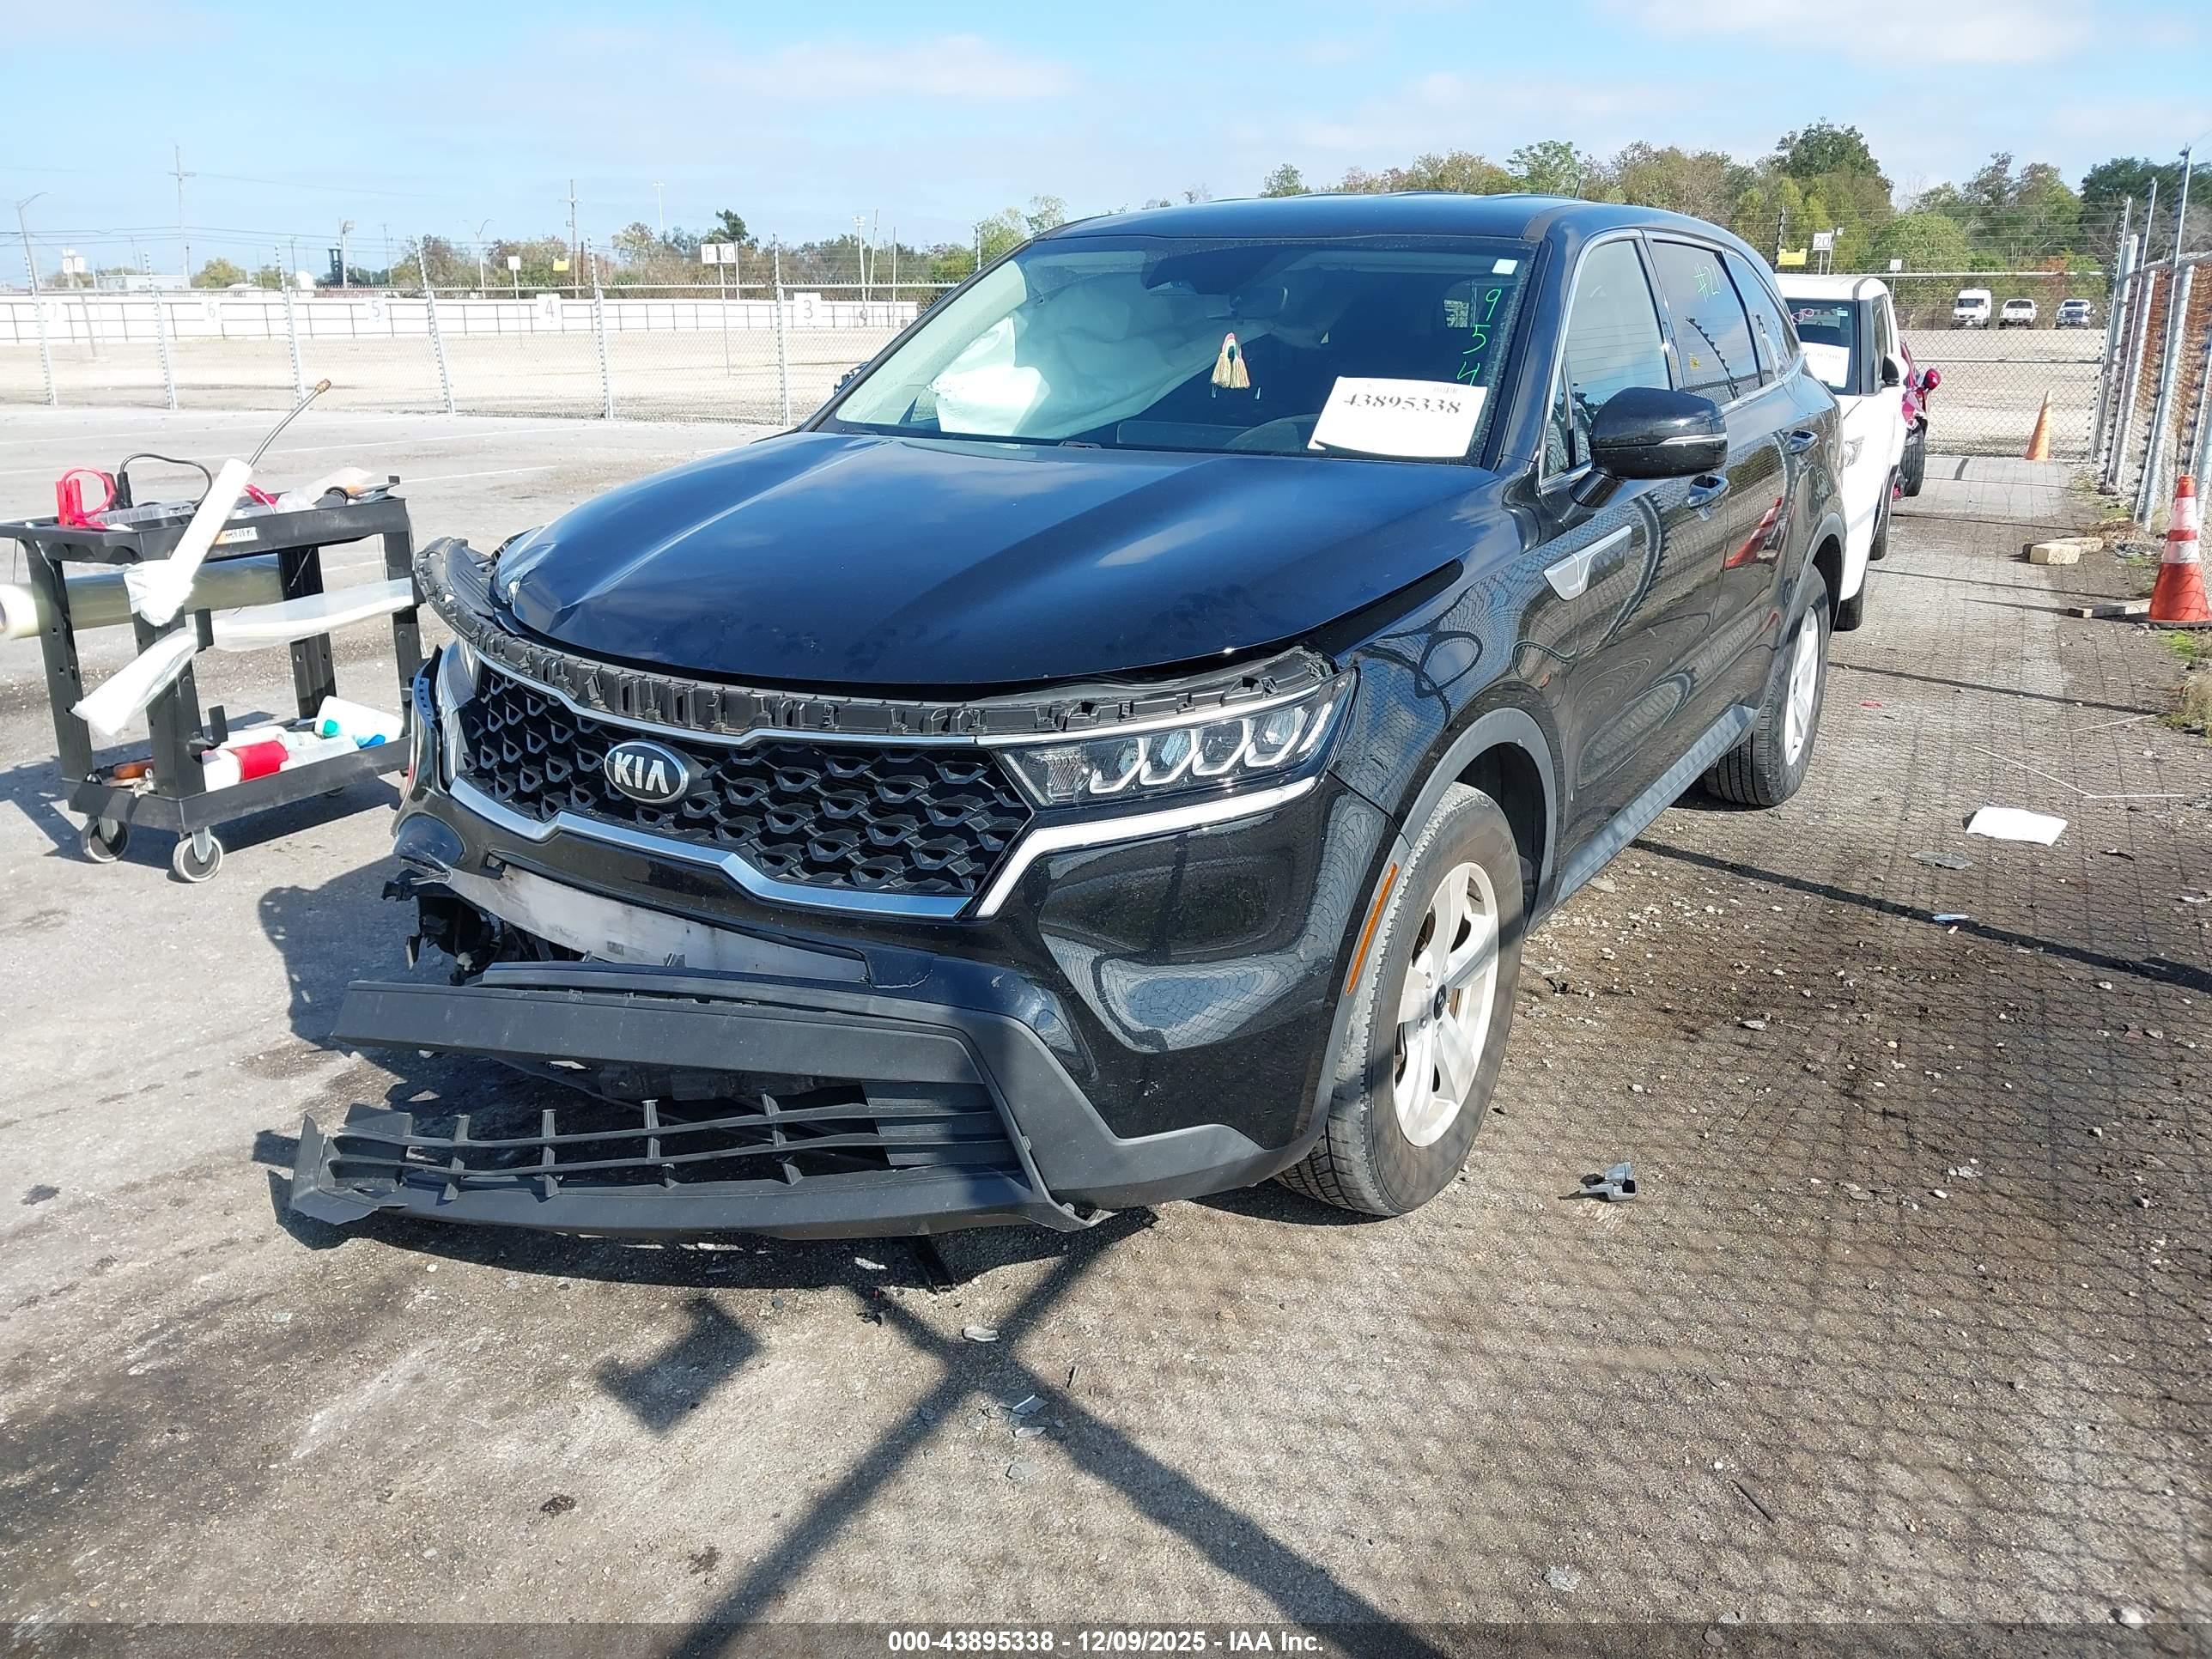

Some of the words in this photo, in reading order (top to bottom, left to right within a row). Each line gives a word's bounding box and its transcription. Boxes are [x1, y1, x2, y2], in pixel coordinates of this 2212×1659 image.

[1814, 236, 1831, 247] 20
[705, 246, 713, 261] F
[723, 246, 733, 261] G
[1693, 263, 1721, 302] #21
[207, 301, 216, 318] 6
[371, 300, 380, 318] 5
[545, 300, 555, 318] 4
[803, 300, 813, 319] 3
[1343, 392, 1462, 414] 43895338
[614, 751, 670, 794] KIA
